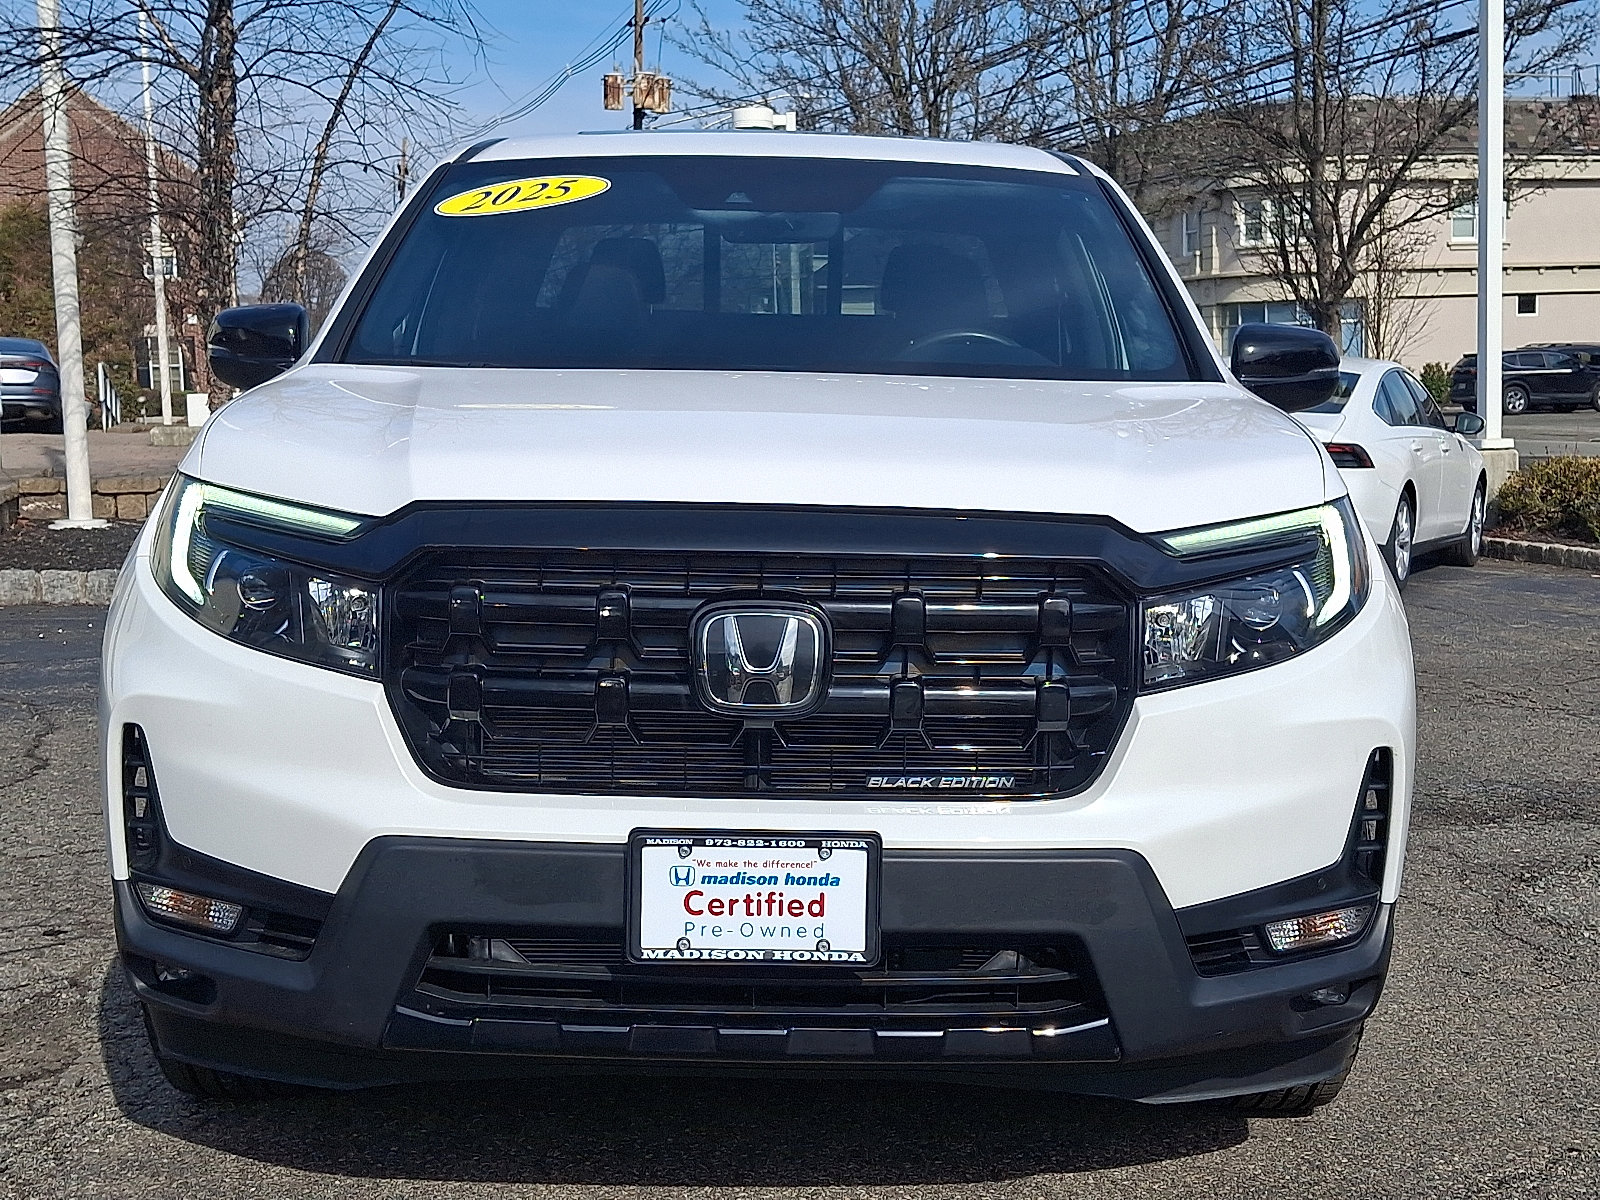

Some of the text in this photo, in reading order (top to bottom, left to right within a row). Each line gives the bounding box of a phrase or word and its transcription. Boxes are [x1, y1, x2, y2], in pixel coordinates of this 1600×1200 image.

[459, 180, 579, 212] 2025
[867, 776, 1016, 789] BLACK EDITION
[821, 840, 869, 849] HONDA
[715, 859, 739, 868] make
[742, 859, 759, 869] the
[700, 872, 841, 887] madison honda
[683, 889, 826, 918] Certified
[684, 921, 825, 939] Pre-Owned
[640, 949, 867, 962] MADISON HONDA
